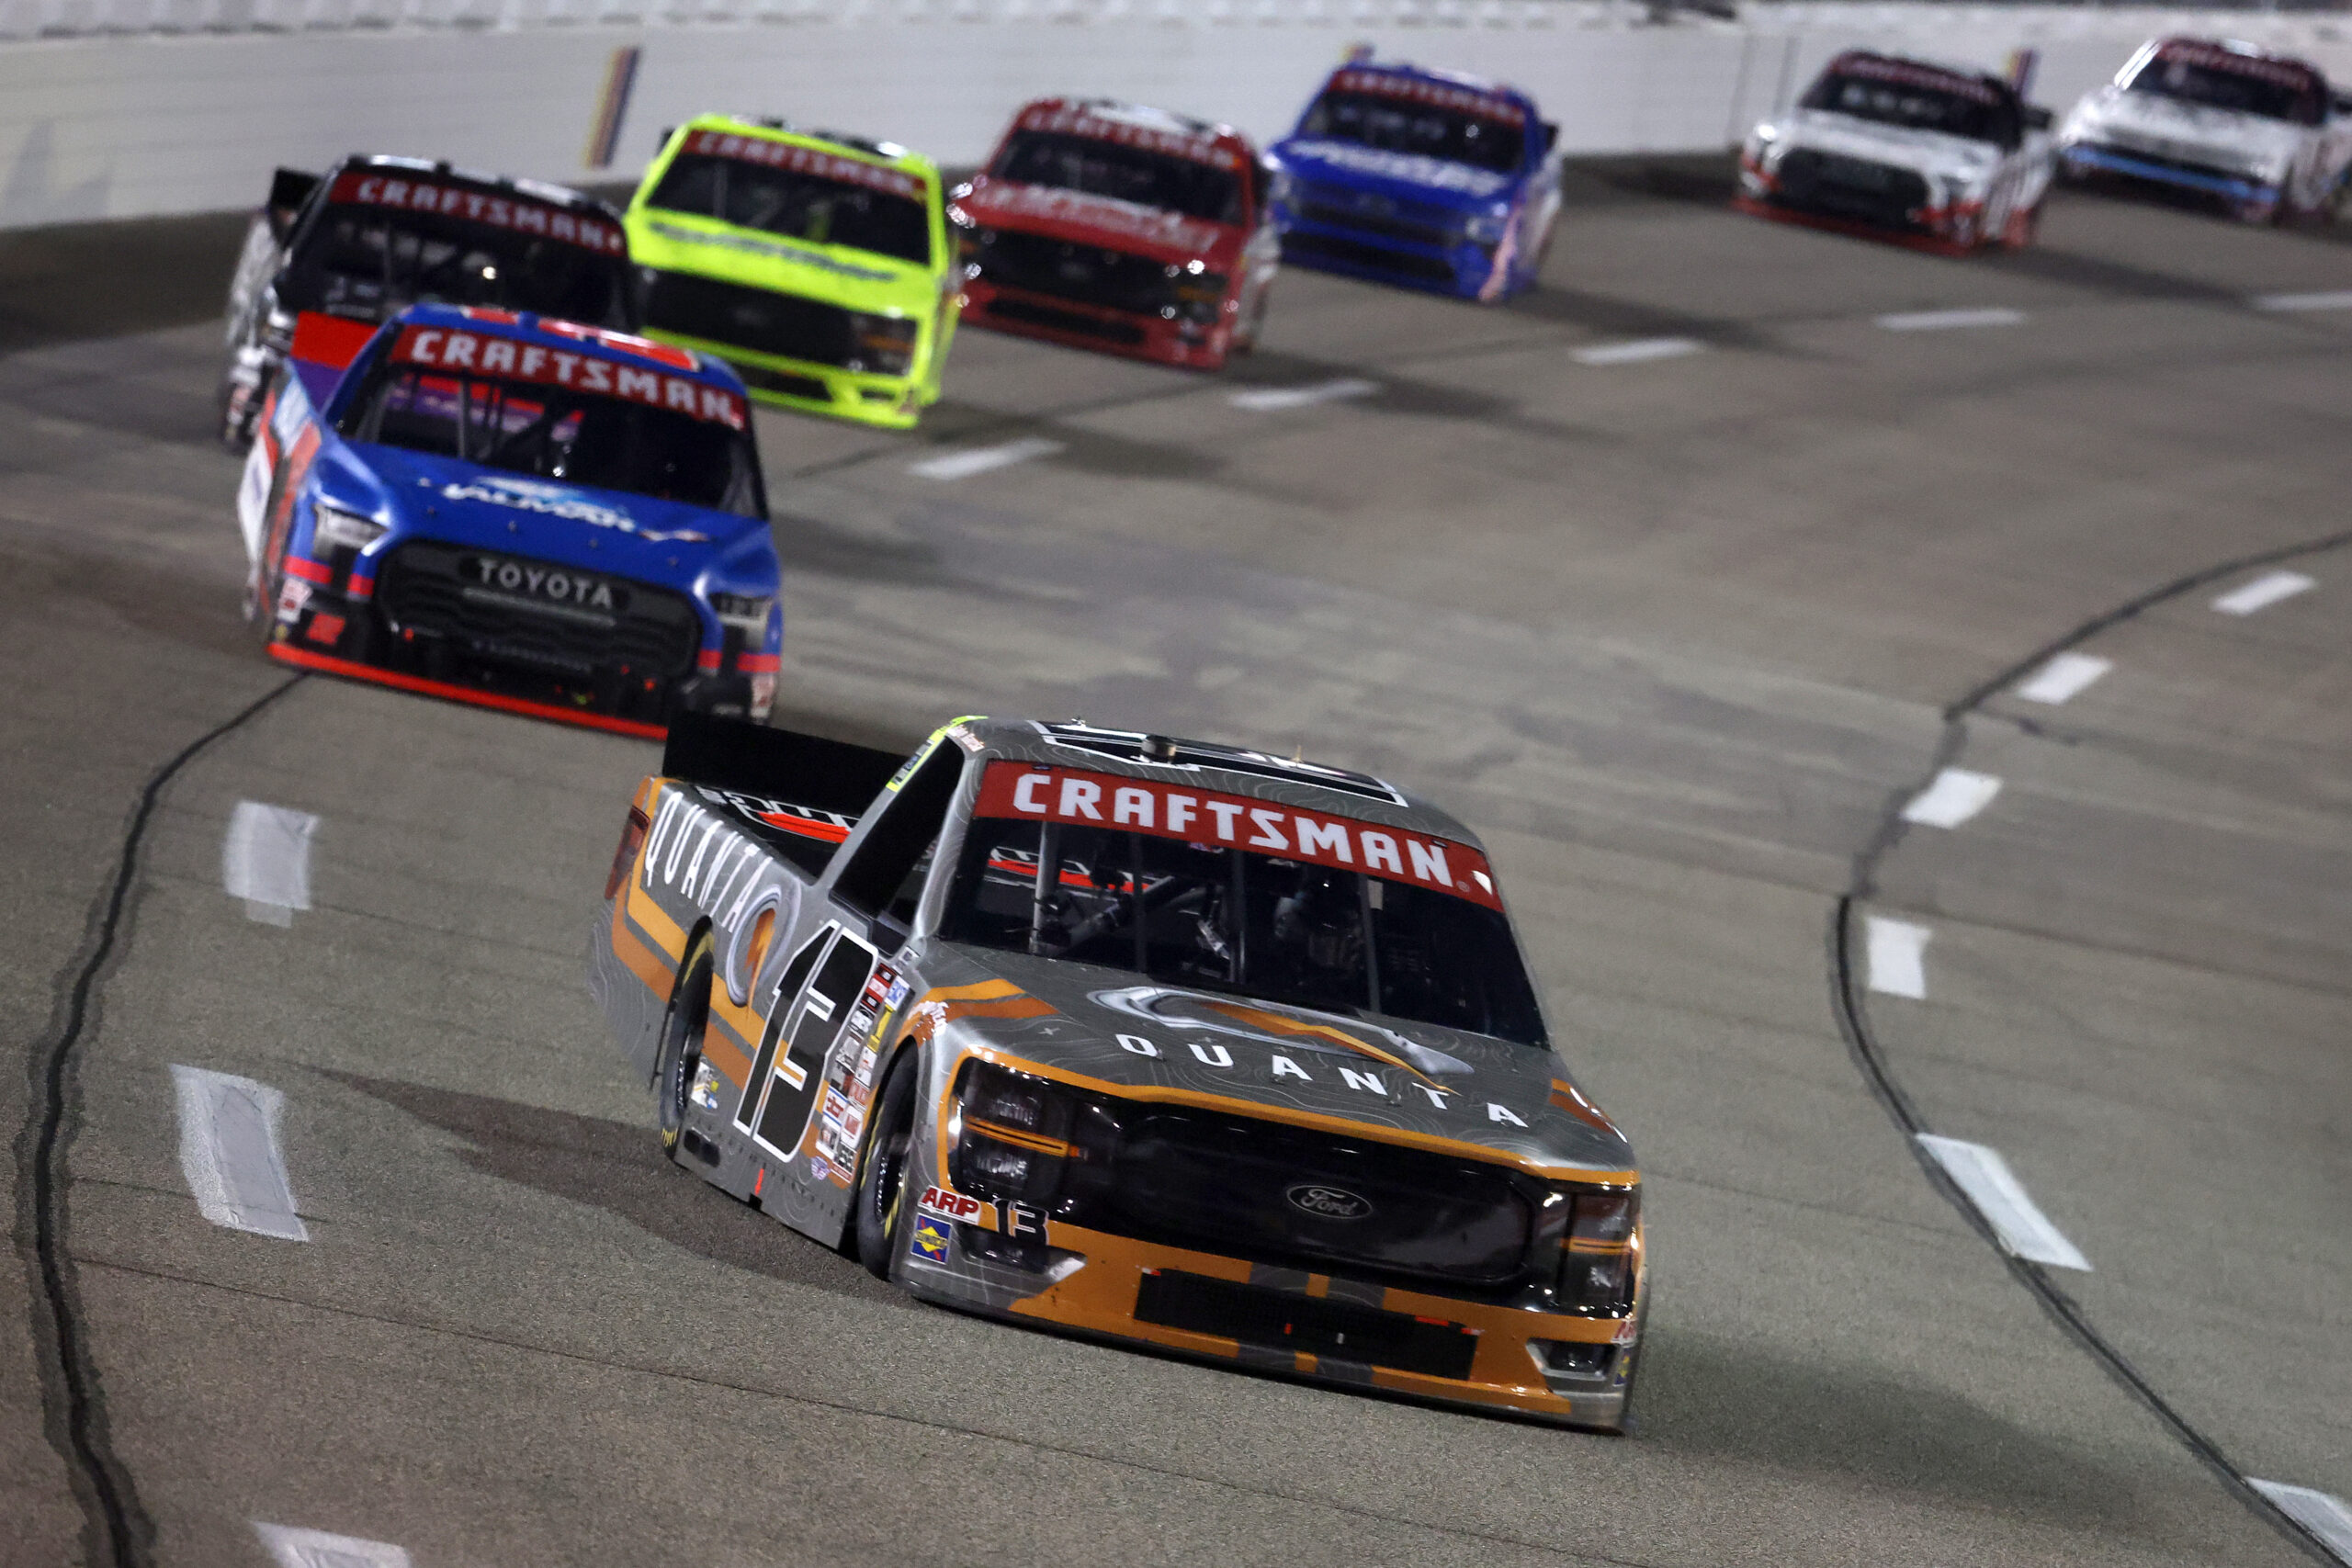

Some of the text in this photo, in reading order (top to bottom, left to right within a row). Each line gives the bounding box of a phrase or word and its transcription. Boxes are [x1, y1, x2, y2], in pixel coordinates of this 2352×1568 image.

[357, 178, 604, 249] CRAFTSMAN
[411, 331, 734, 424] CRAFTSMAN
[480, 558, 613, 610] TOYOTA
[1012, 773, 1454, 888] CRAFTSMAN
[1114, 1033, 1529, 1128] QUANTA
[922, 1188, 979, 1217] ARP
[1300, 1188, 1359, 1216] Ford
